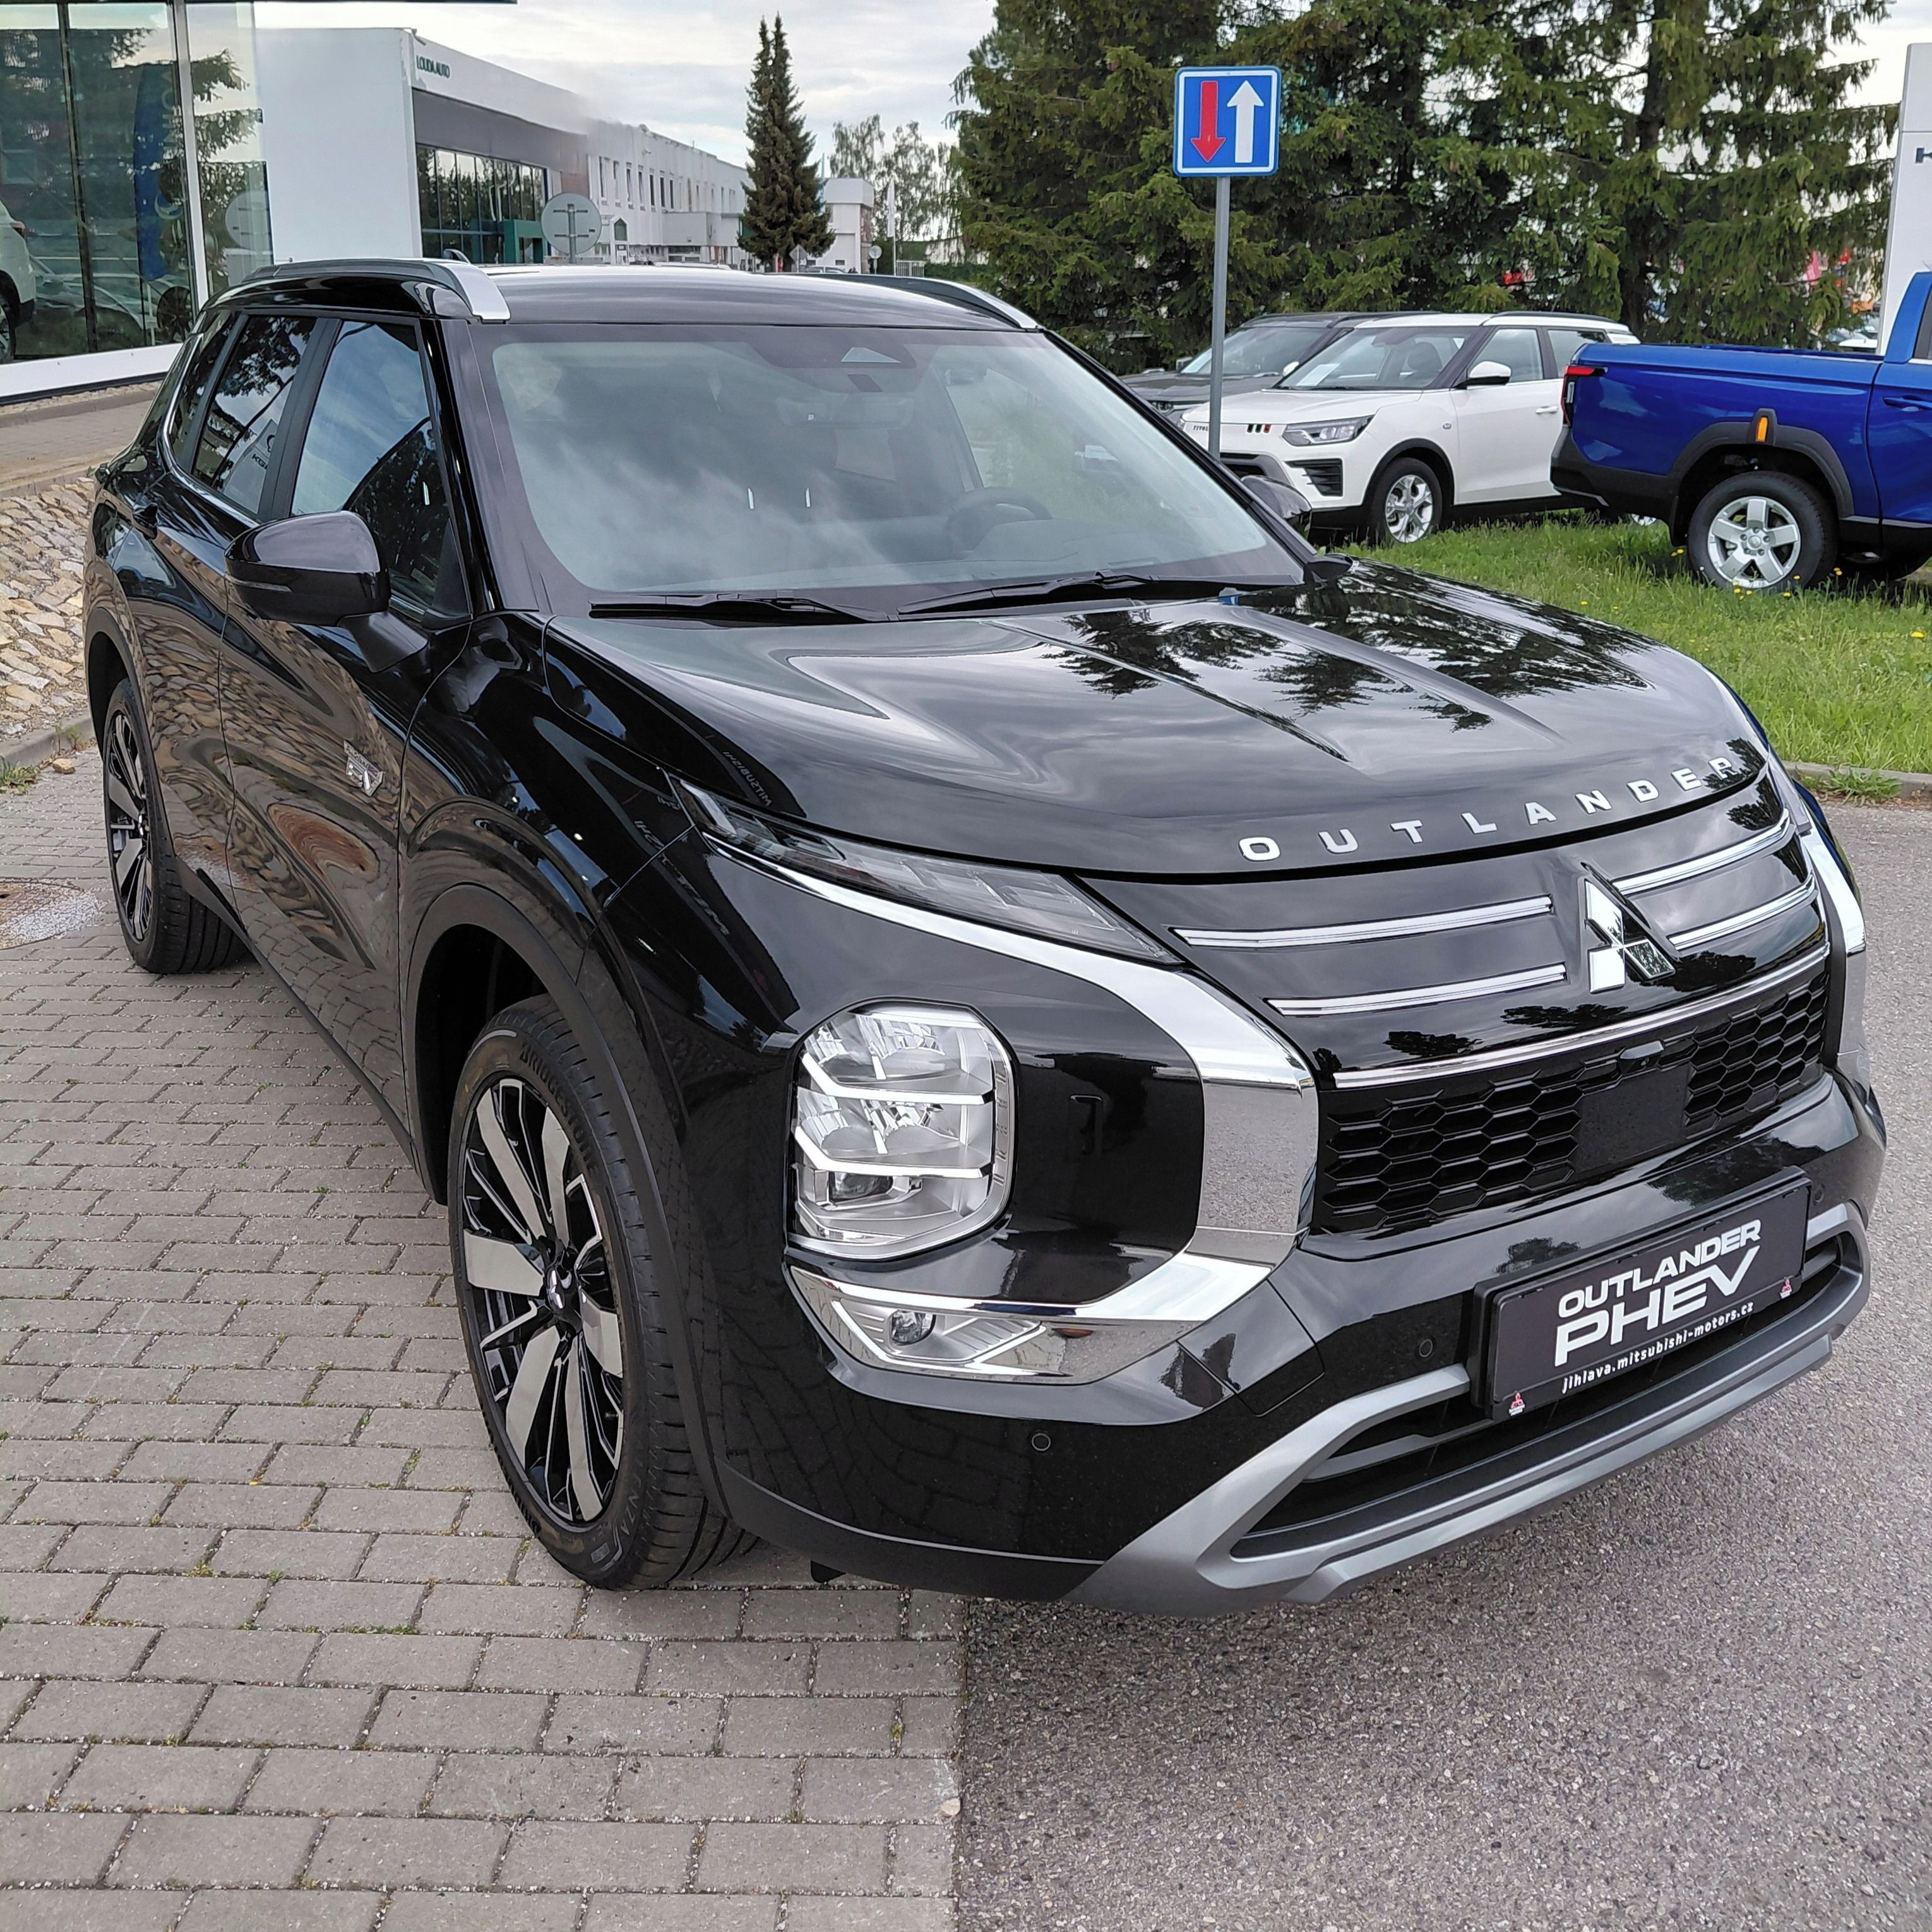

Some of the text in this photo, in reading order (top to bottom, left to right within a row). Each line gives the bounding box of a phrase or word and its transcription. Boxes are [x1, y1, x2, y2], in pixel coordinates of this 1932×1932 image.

[1238, 756, 1738, 862] OUTLANDER
[1554, 1245, 1760, 1368] PHEV
[1558, 1219, 1762, 1318] OUTLANDER
[1561, 1301, 1754, 1394] jihlava.mitsubishi-motors.cz
